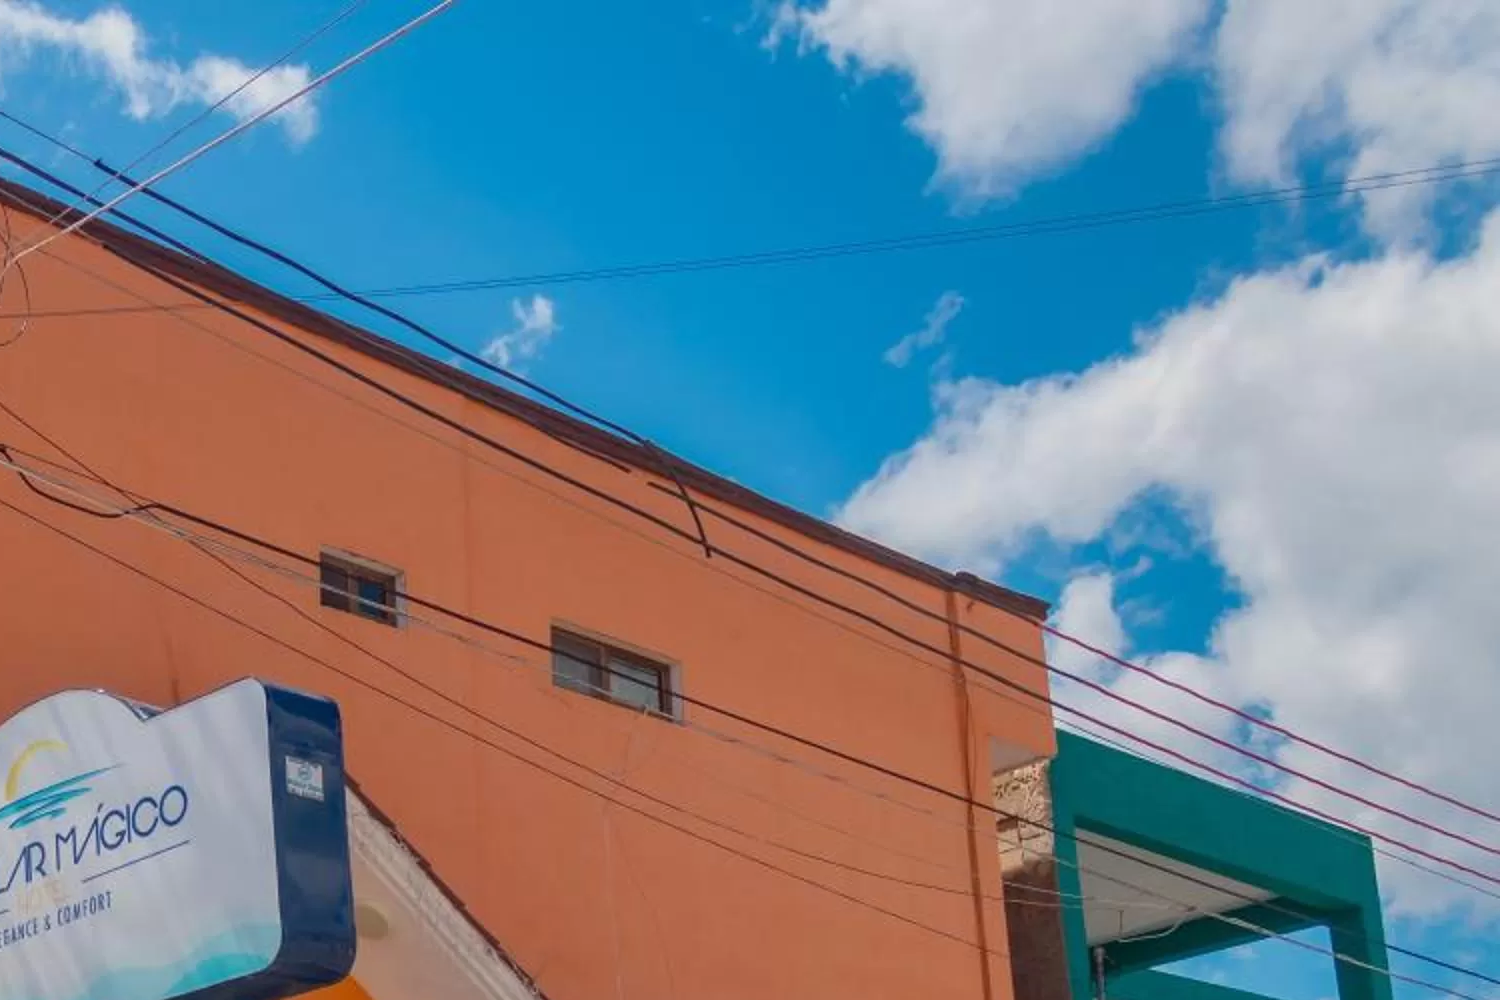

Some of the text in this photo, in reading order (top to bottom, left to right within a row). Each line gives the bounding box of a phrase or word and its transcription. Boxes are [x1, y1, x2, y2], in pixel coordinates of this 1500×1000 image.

[55, 785, 189, 871] MÁGICO
[44, 914, 52, 930] &
[57, 890, 113, 928] COMFORT
